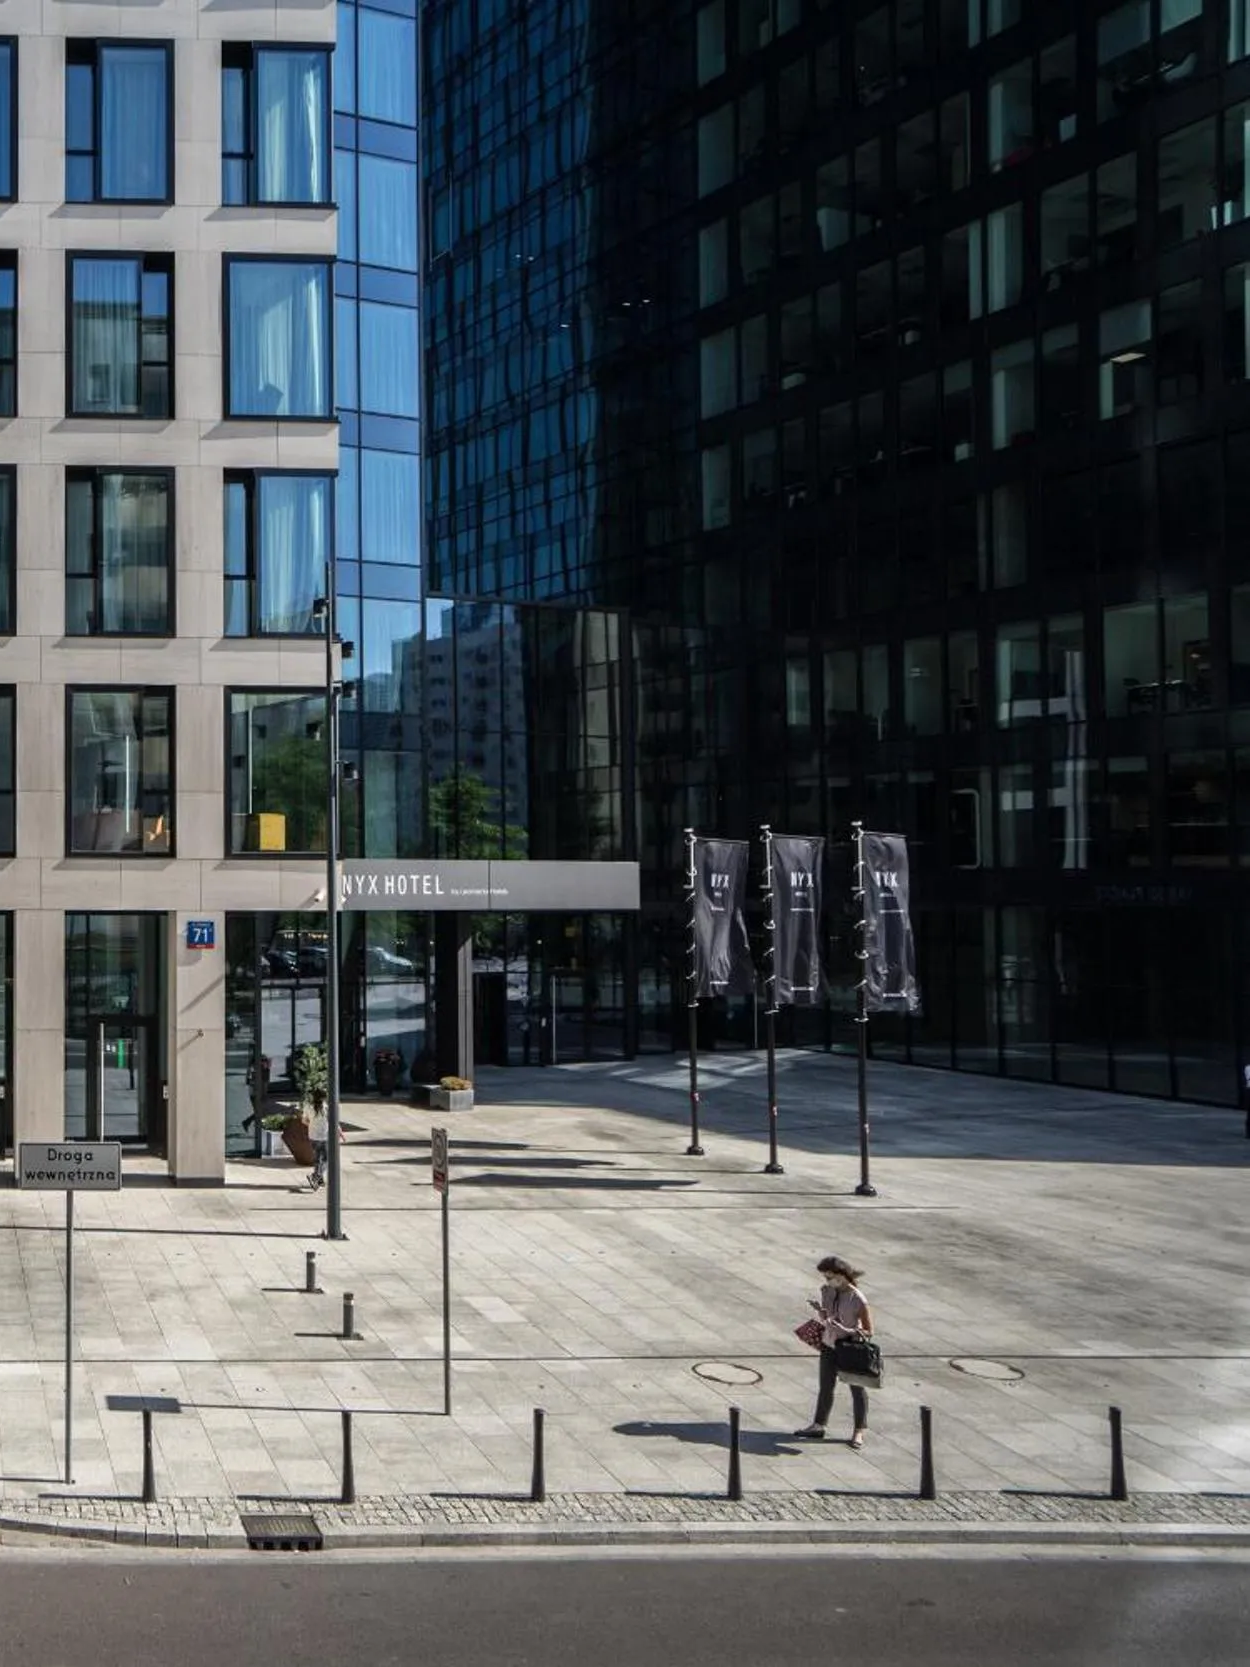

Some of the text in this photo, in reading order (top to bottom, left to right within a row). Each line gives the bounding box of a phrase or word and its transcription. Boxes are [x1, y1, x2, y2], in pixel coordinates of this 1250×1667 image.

[342, 875, 379, 894] NYX
[385, 875, 445, 895] HOTEL
[193, 927, 208, 943] 71
[47, 1148, 94, 1164] Droga
[24, 1168, 116, 1182] wewnętrzna
